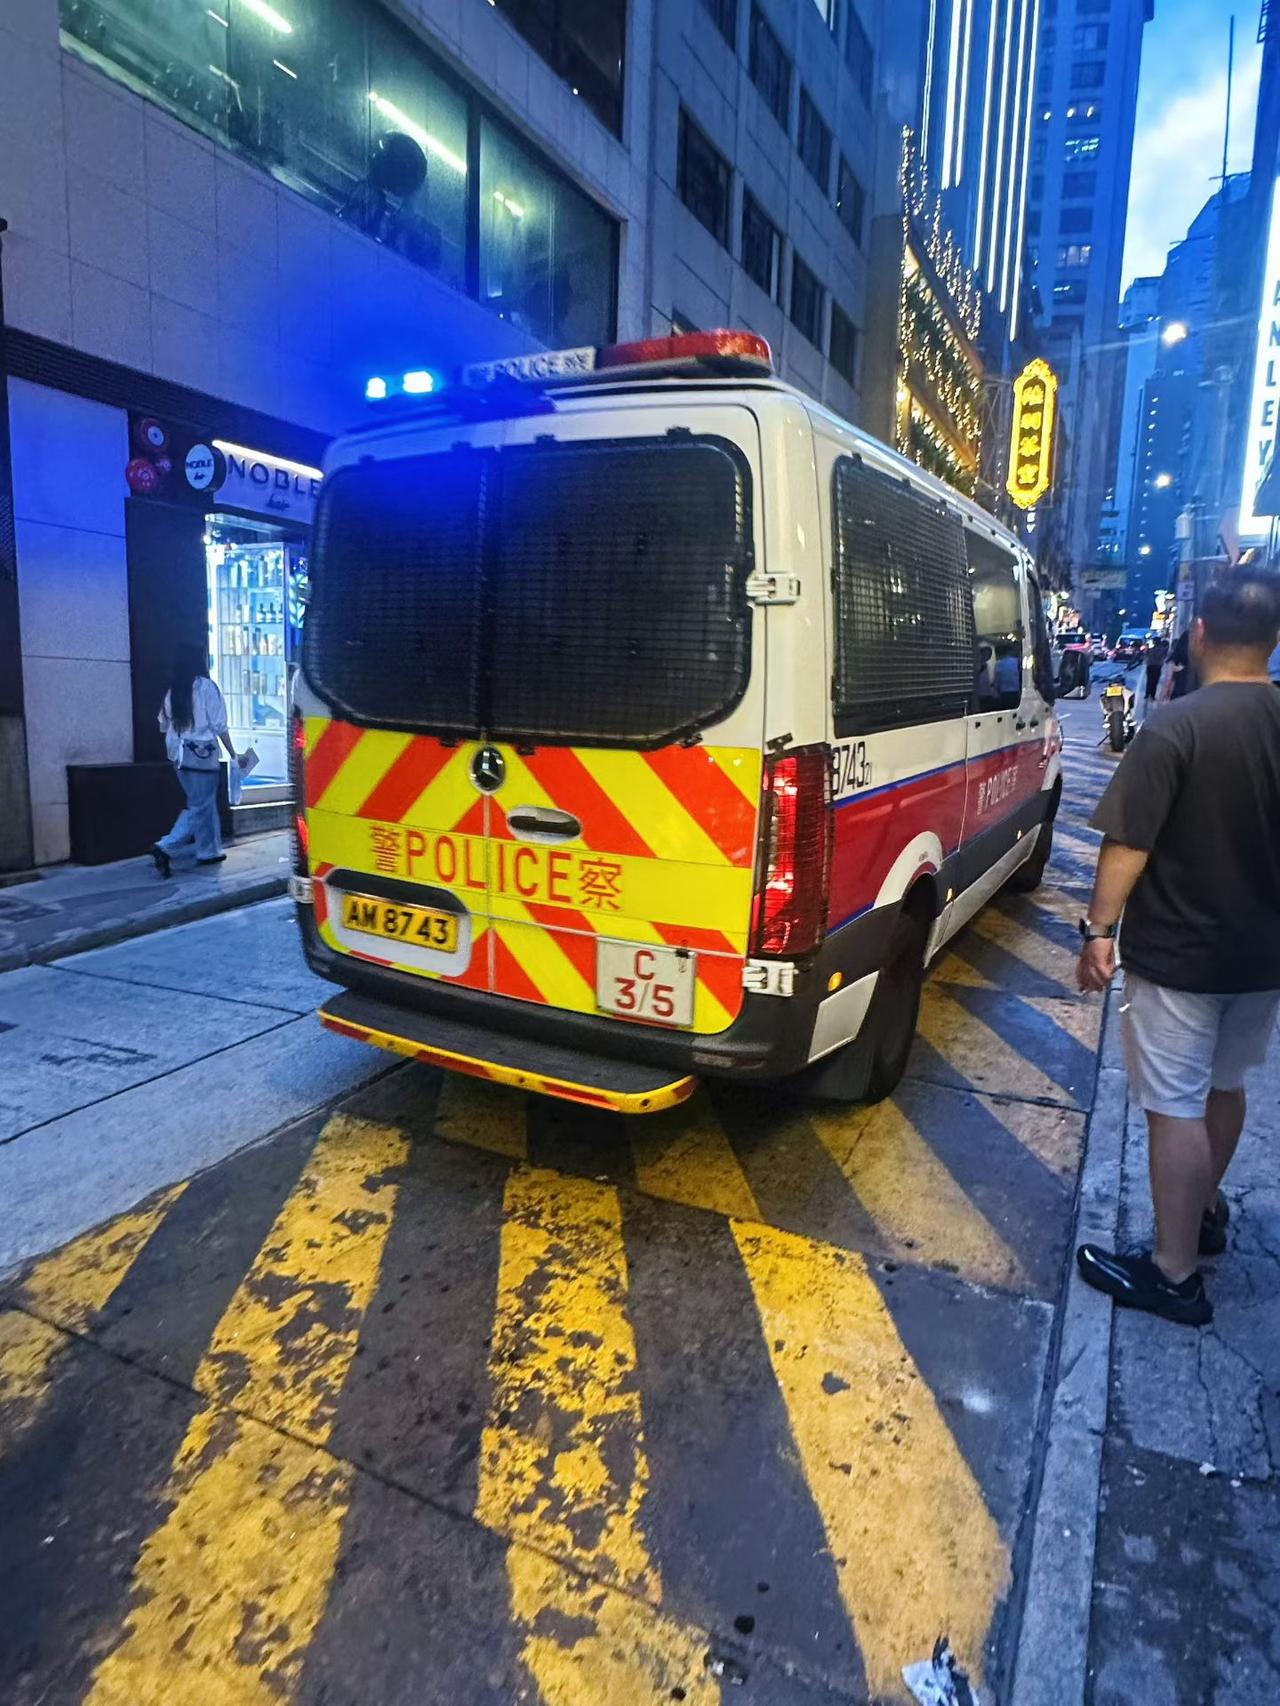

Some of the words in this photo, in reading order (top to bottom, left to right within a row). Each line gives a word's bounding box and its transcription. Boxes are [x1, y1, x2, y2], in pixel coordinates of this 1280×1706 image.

[228, 454, 321, 500] NOBLE
[404, 829, 573, 904] POLICE
[347, 901, 378, 929] AM
[383, 908, 449, 944] 8743
[634, 950, 656, 981] C
[614, 977, 674, 1018] 3/5
